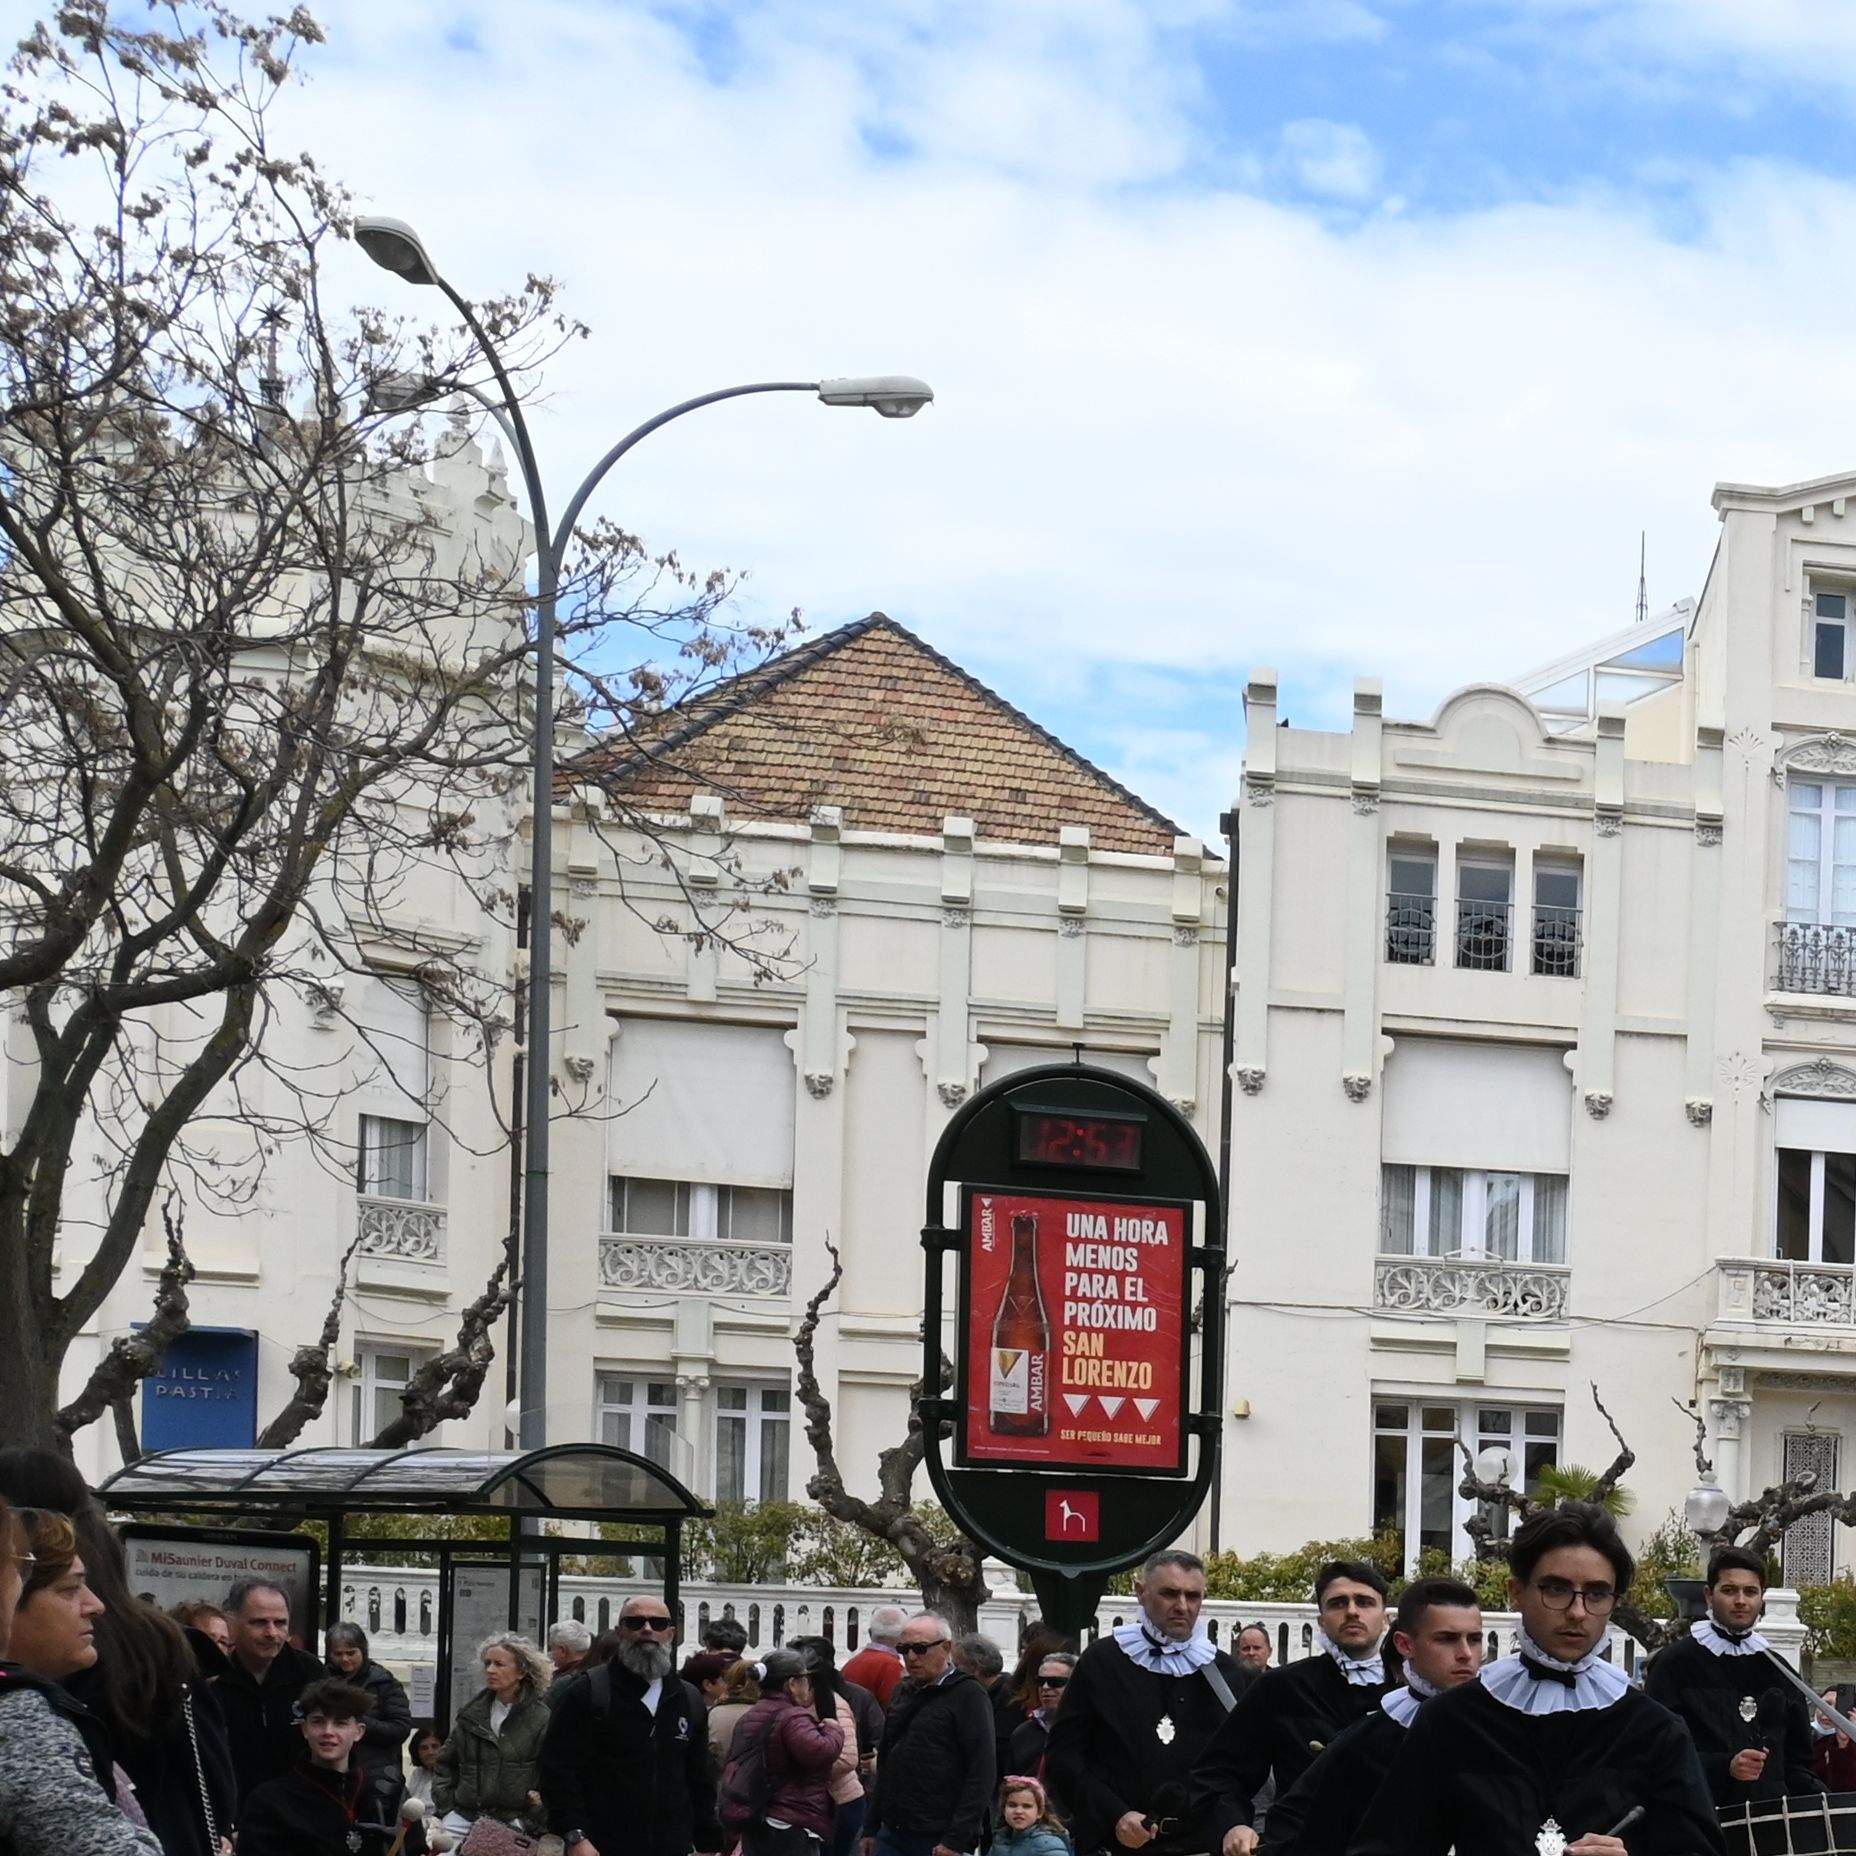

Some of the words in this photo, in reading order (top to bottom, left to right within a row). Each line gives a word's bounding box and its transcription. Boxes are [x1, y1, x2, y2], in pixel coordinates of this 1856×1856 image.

[980, 1208, 993, 1252] AMBAR
[1066, 1212, 1107, 1240] UNA
[1114, 1217, 1169, 1246] HORA
[1065, 1242, 1138, 1272] MENOS
[1064, 1272, 1119, 1300] PARA
[1124, 1276, 1149, 1302] EL
[1064, 1300, 1157, 1332] PRÓXIMO
[1063, 1330, 1104, 1357] SAN
[1030, 1353, 1044, 1412] AMBAR
[1062, 1357, 1152, 1390] LORENZO
[1060, 1429, 1076, 1440] SER
[1135, 1434, 1162, 1446] MEJOR
[215, 1556, 247, 1570] Duval
[250, 1559, 296, 1573] Connect
